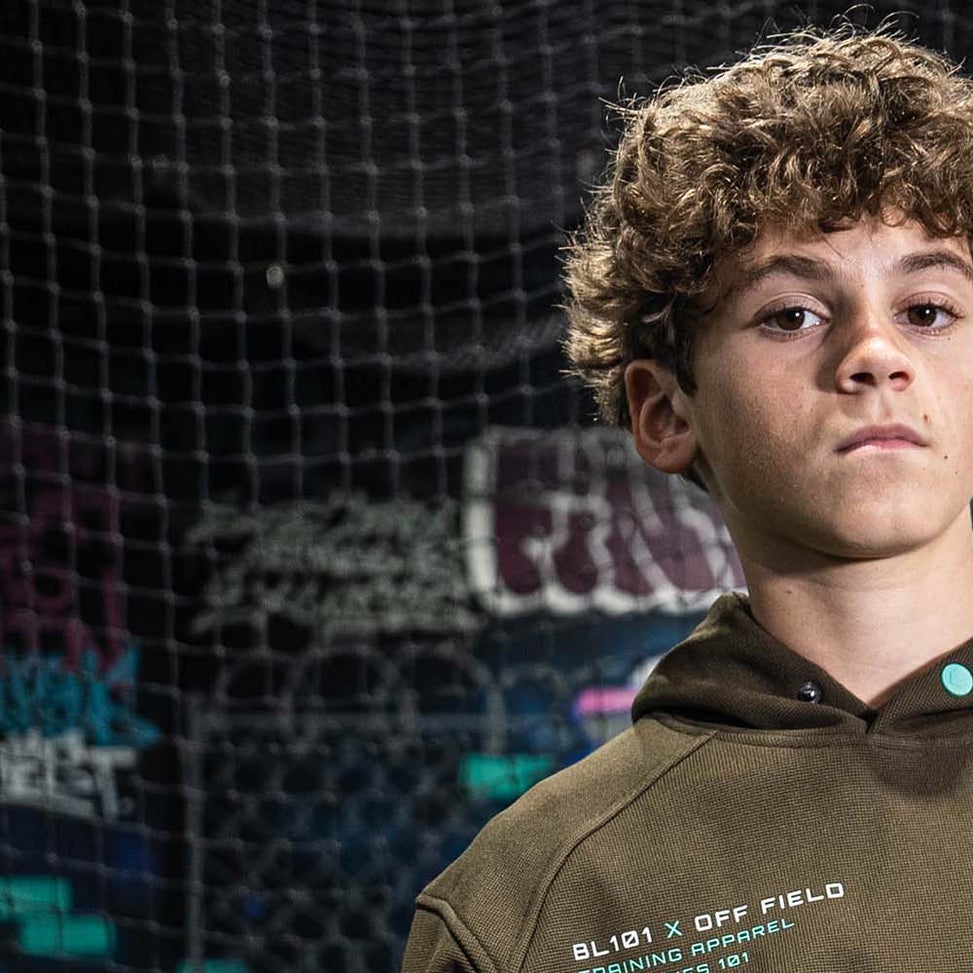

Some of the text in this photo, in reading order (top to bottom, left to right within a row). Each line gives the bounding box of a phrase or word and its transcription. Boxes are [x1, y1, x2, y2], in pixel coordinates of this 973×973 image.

[572, 882, 845, 961] BL101 X OFF FIELD
[691, 918, 795, 957] APPAREL
[718, 951, 750, 970] 101
